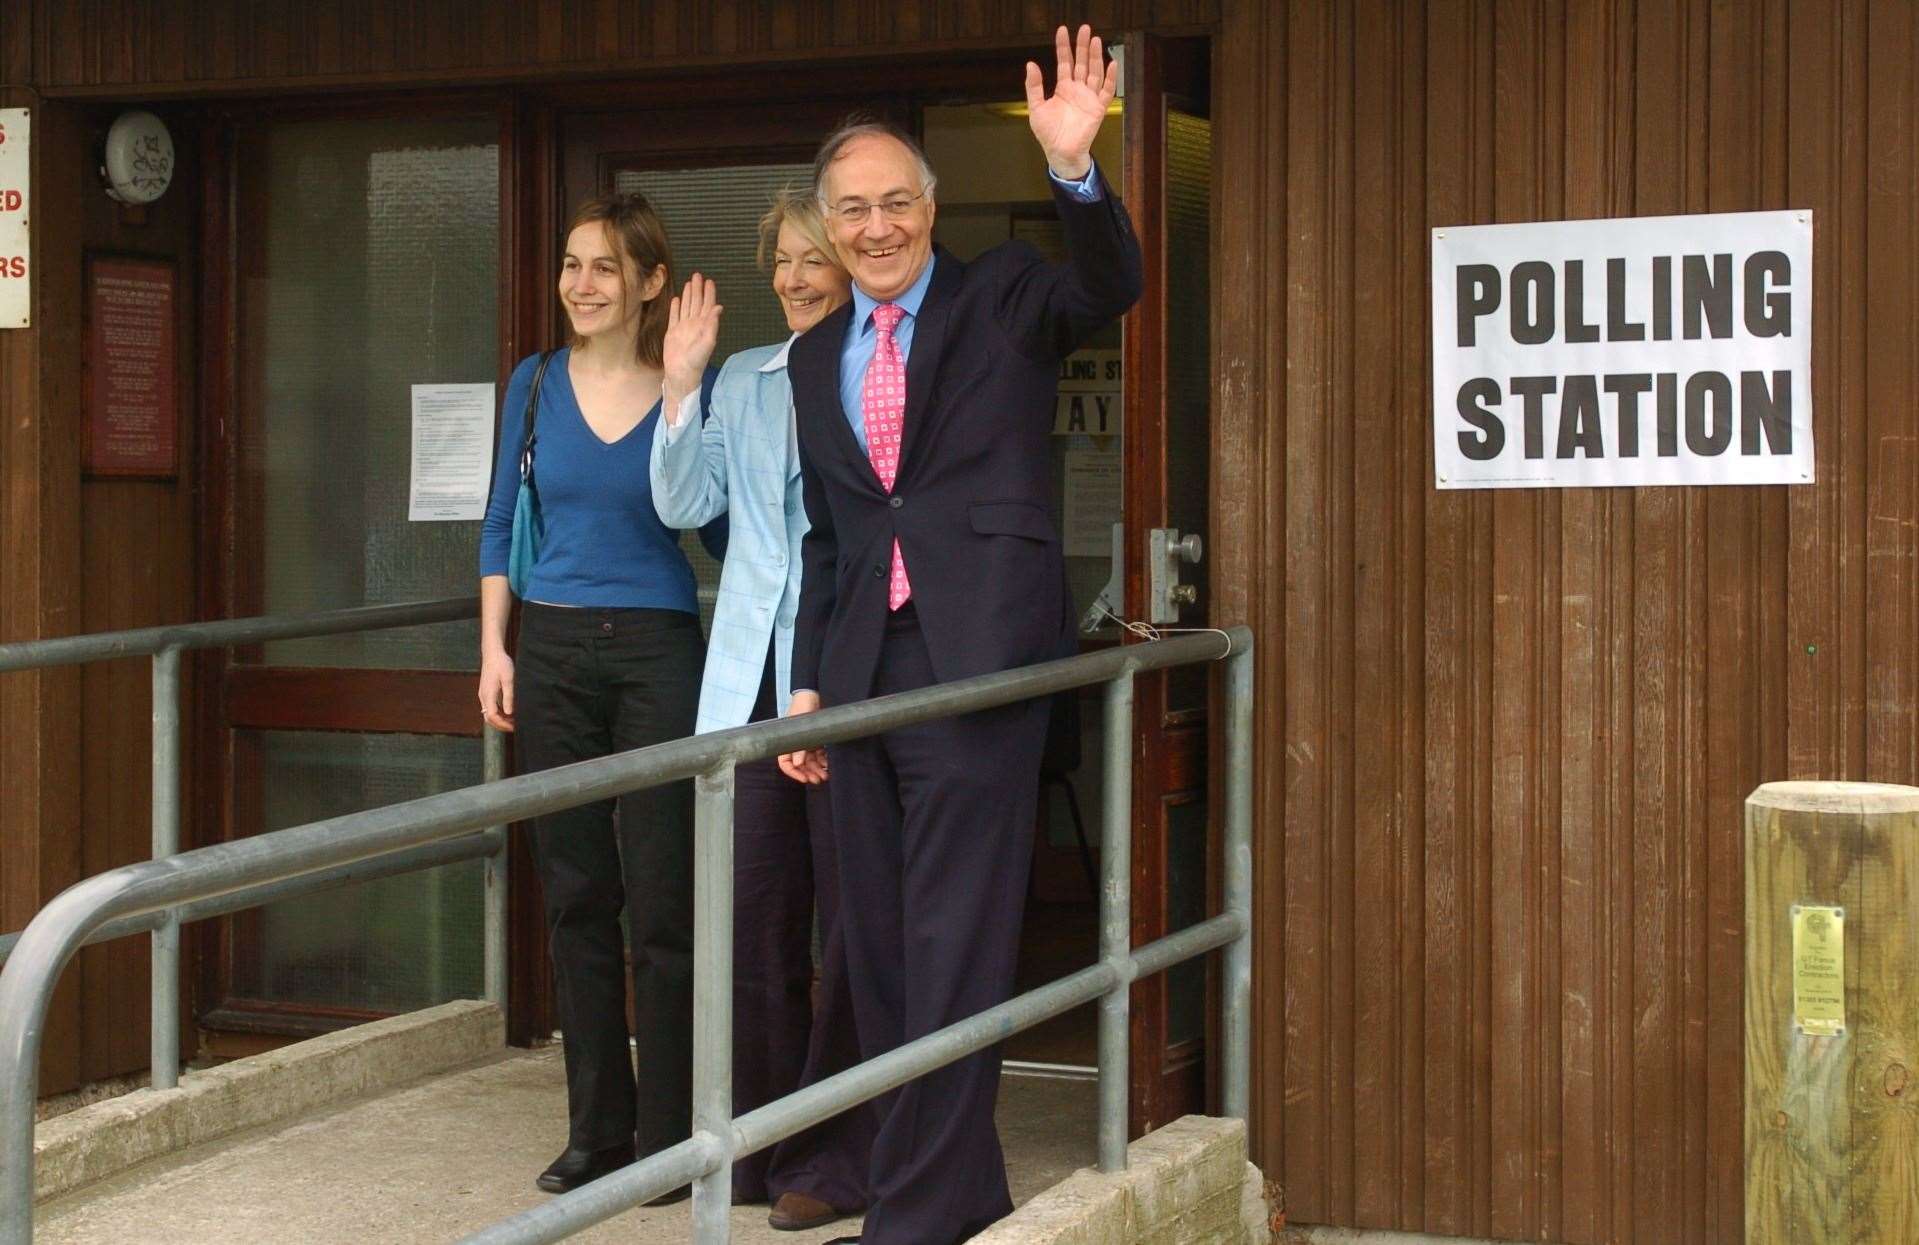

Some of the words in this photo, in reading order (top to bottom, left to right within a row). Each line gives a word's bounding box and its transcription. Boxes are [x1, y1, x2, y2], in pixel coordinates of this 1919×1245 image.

[1456, 250, 1792, 347] POLLING
[1105, 359, 1122, 381] ST
[1456, 370, 1792, 461] STATION
